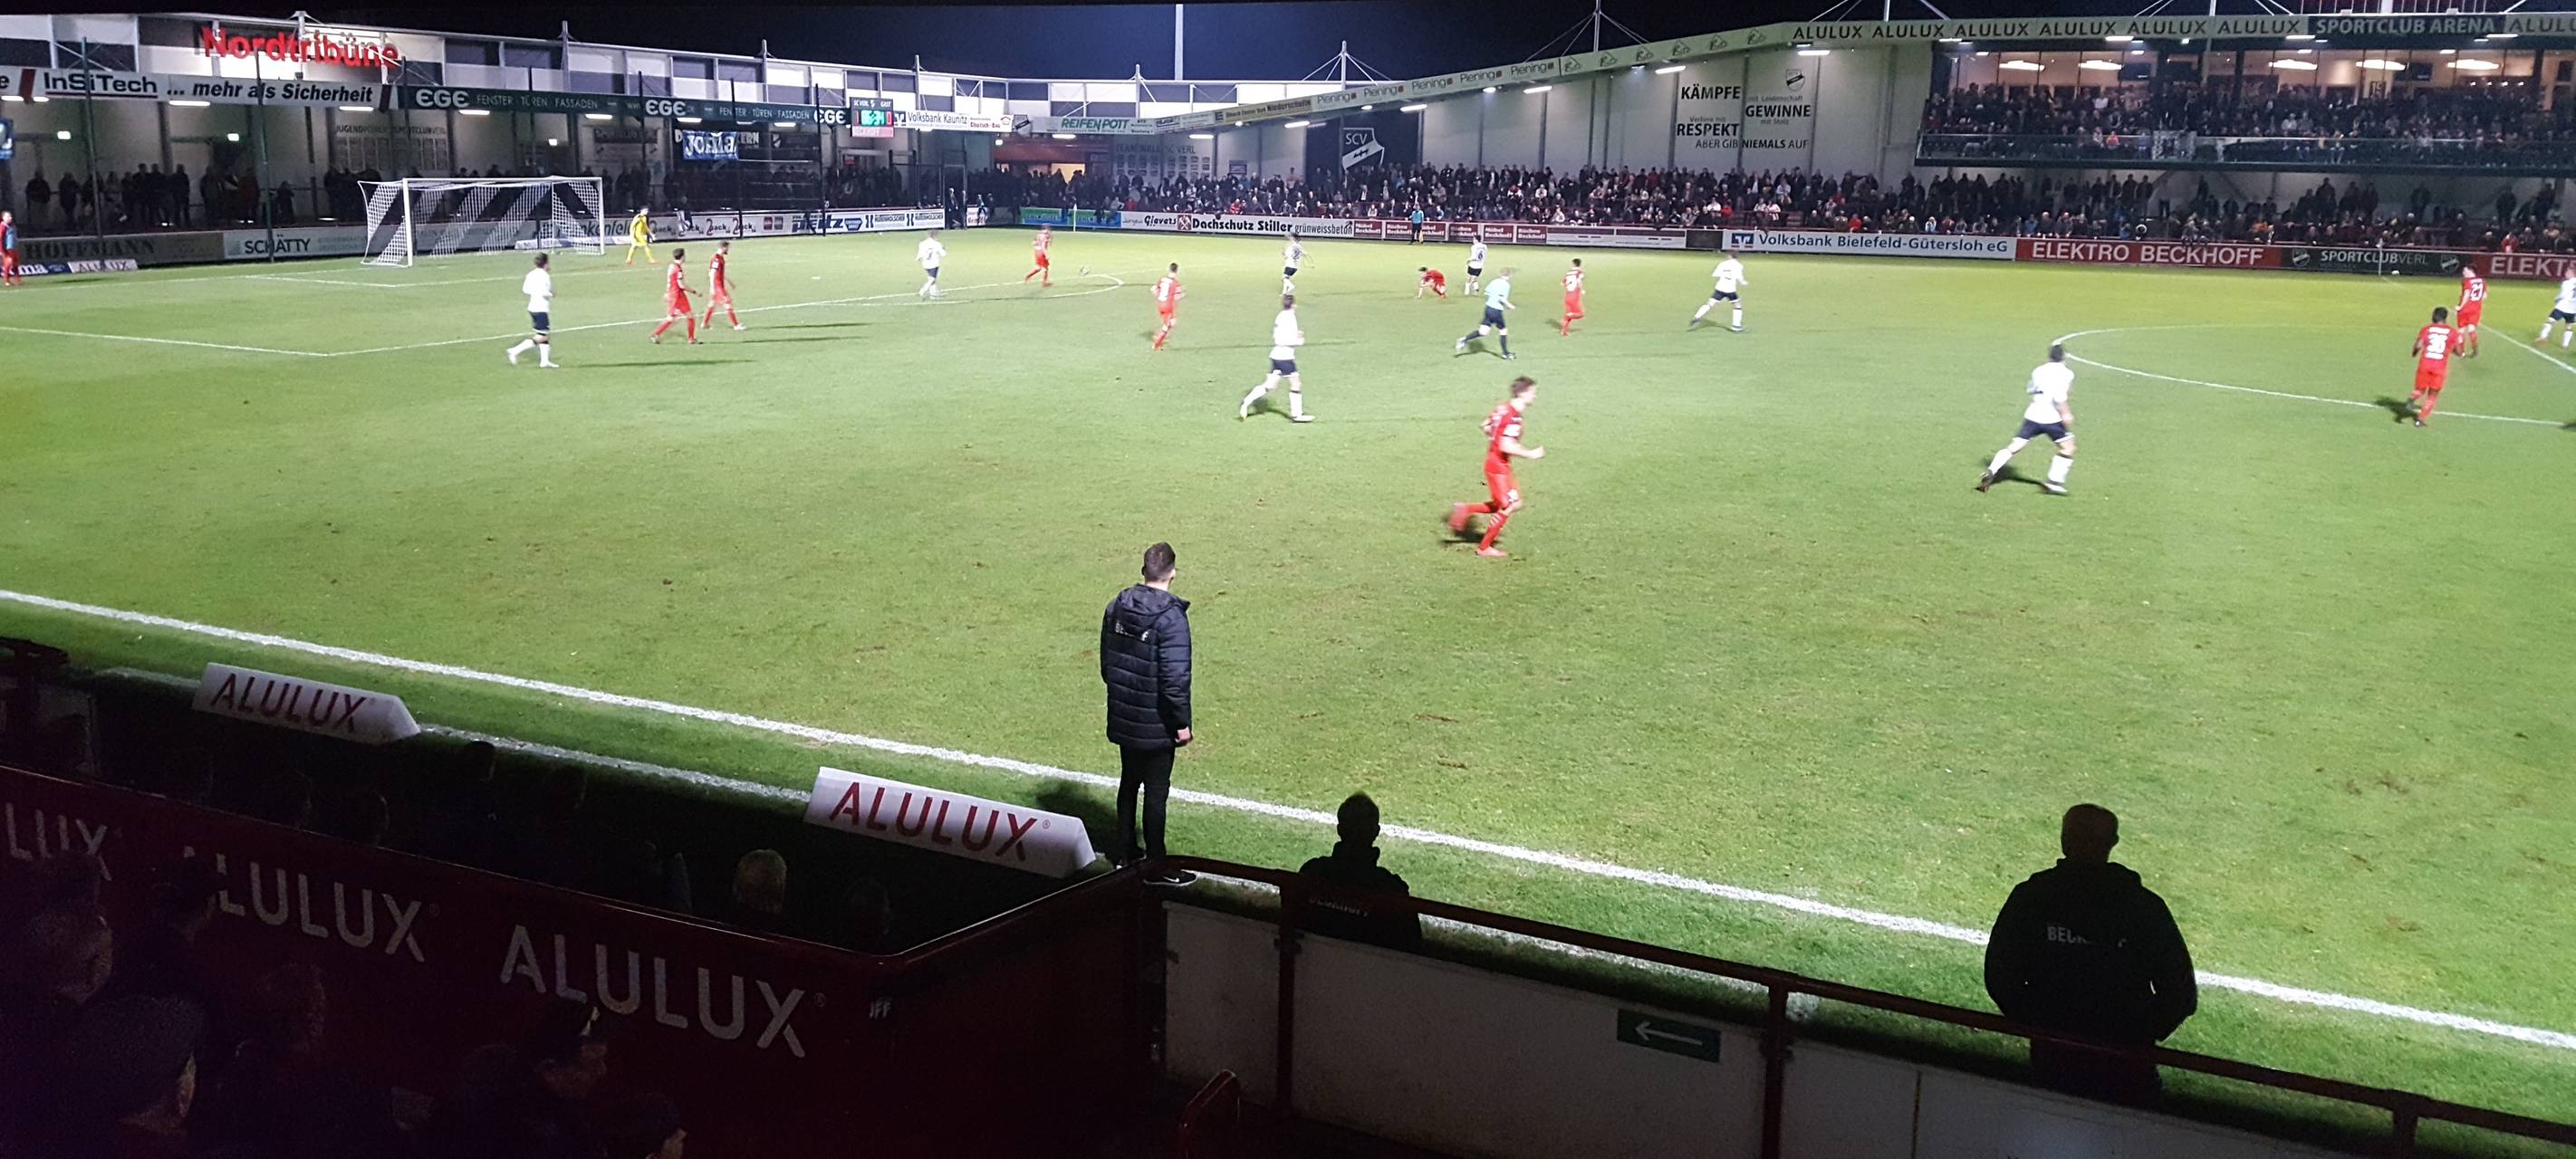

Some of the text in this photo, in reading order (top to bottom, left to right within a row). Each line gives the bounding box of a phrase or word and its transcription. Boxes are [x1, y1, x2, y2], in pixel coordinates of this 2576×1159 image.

[1793, 20, 2300, 39] ALULUX ALULUX ALULUX ALULUX ALULUX ALULUX
[2315, 18, 2494, 34] SPORTCLUB ARENA
[202, 26, 400, 70] Nordtribüne
[1459, 70, 1495, 84] Piening
[1510, 62, 1547, 76] Piening
[43, 72, 158, 93] InSiTech
[192, 81, 243, 97] mehr
[247, 82, 276, 99] als
[281, 83, 373, 102] Sicherheit
[1363, 85, 1398, 99] Piening
[1411, 77, 1447, 91] Piening
[1681, 83, 1741, 100] KÄMPFE
[416, 89, 470, 109] EGE
[476, 94, 513, 105] FENSTER
[554, 97, 599, 109] FASSADEN
[1317, 91, 1350, 104] Piening
[645, 100, 687, 116] EGE
[719, 106, 747, 117] FENTER
[777, 110, 810, 120] FASSADEN
[813, 110, 846, 125] EGE
[908, 111, 941, 123] Volksbank
[1745, 104, 1812, 118] GEWINNE
[1677, 123, 1740, 137] RESPEKT
[1345, 133, 1368, 145] SCV
[1696, 139, 1809, 149] ABER GIB NIEMALS AUF
[1192, 218, 1293, 233] Dachschutz Stiller
[1759, 233, 2008, 253] Volksbank Bielefeld-Gütersloh eG
[2032, 242, 2265, 265] ELEKTRO BECKHOFF
[210, 673, 367, 733] ALULUX
[829, 781, 1038, 862] ALULUX
[184, 844, 426, 963] LULUX
[499, 924, 807, 1058] ALULUX
